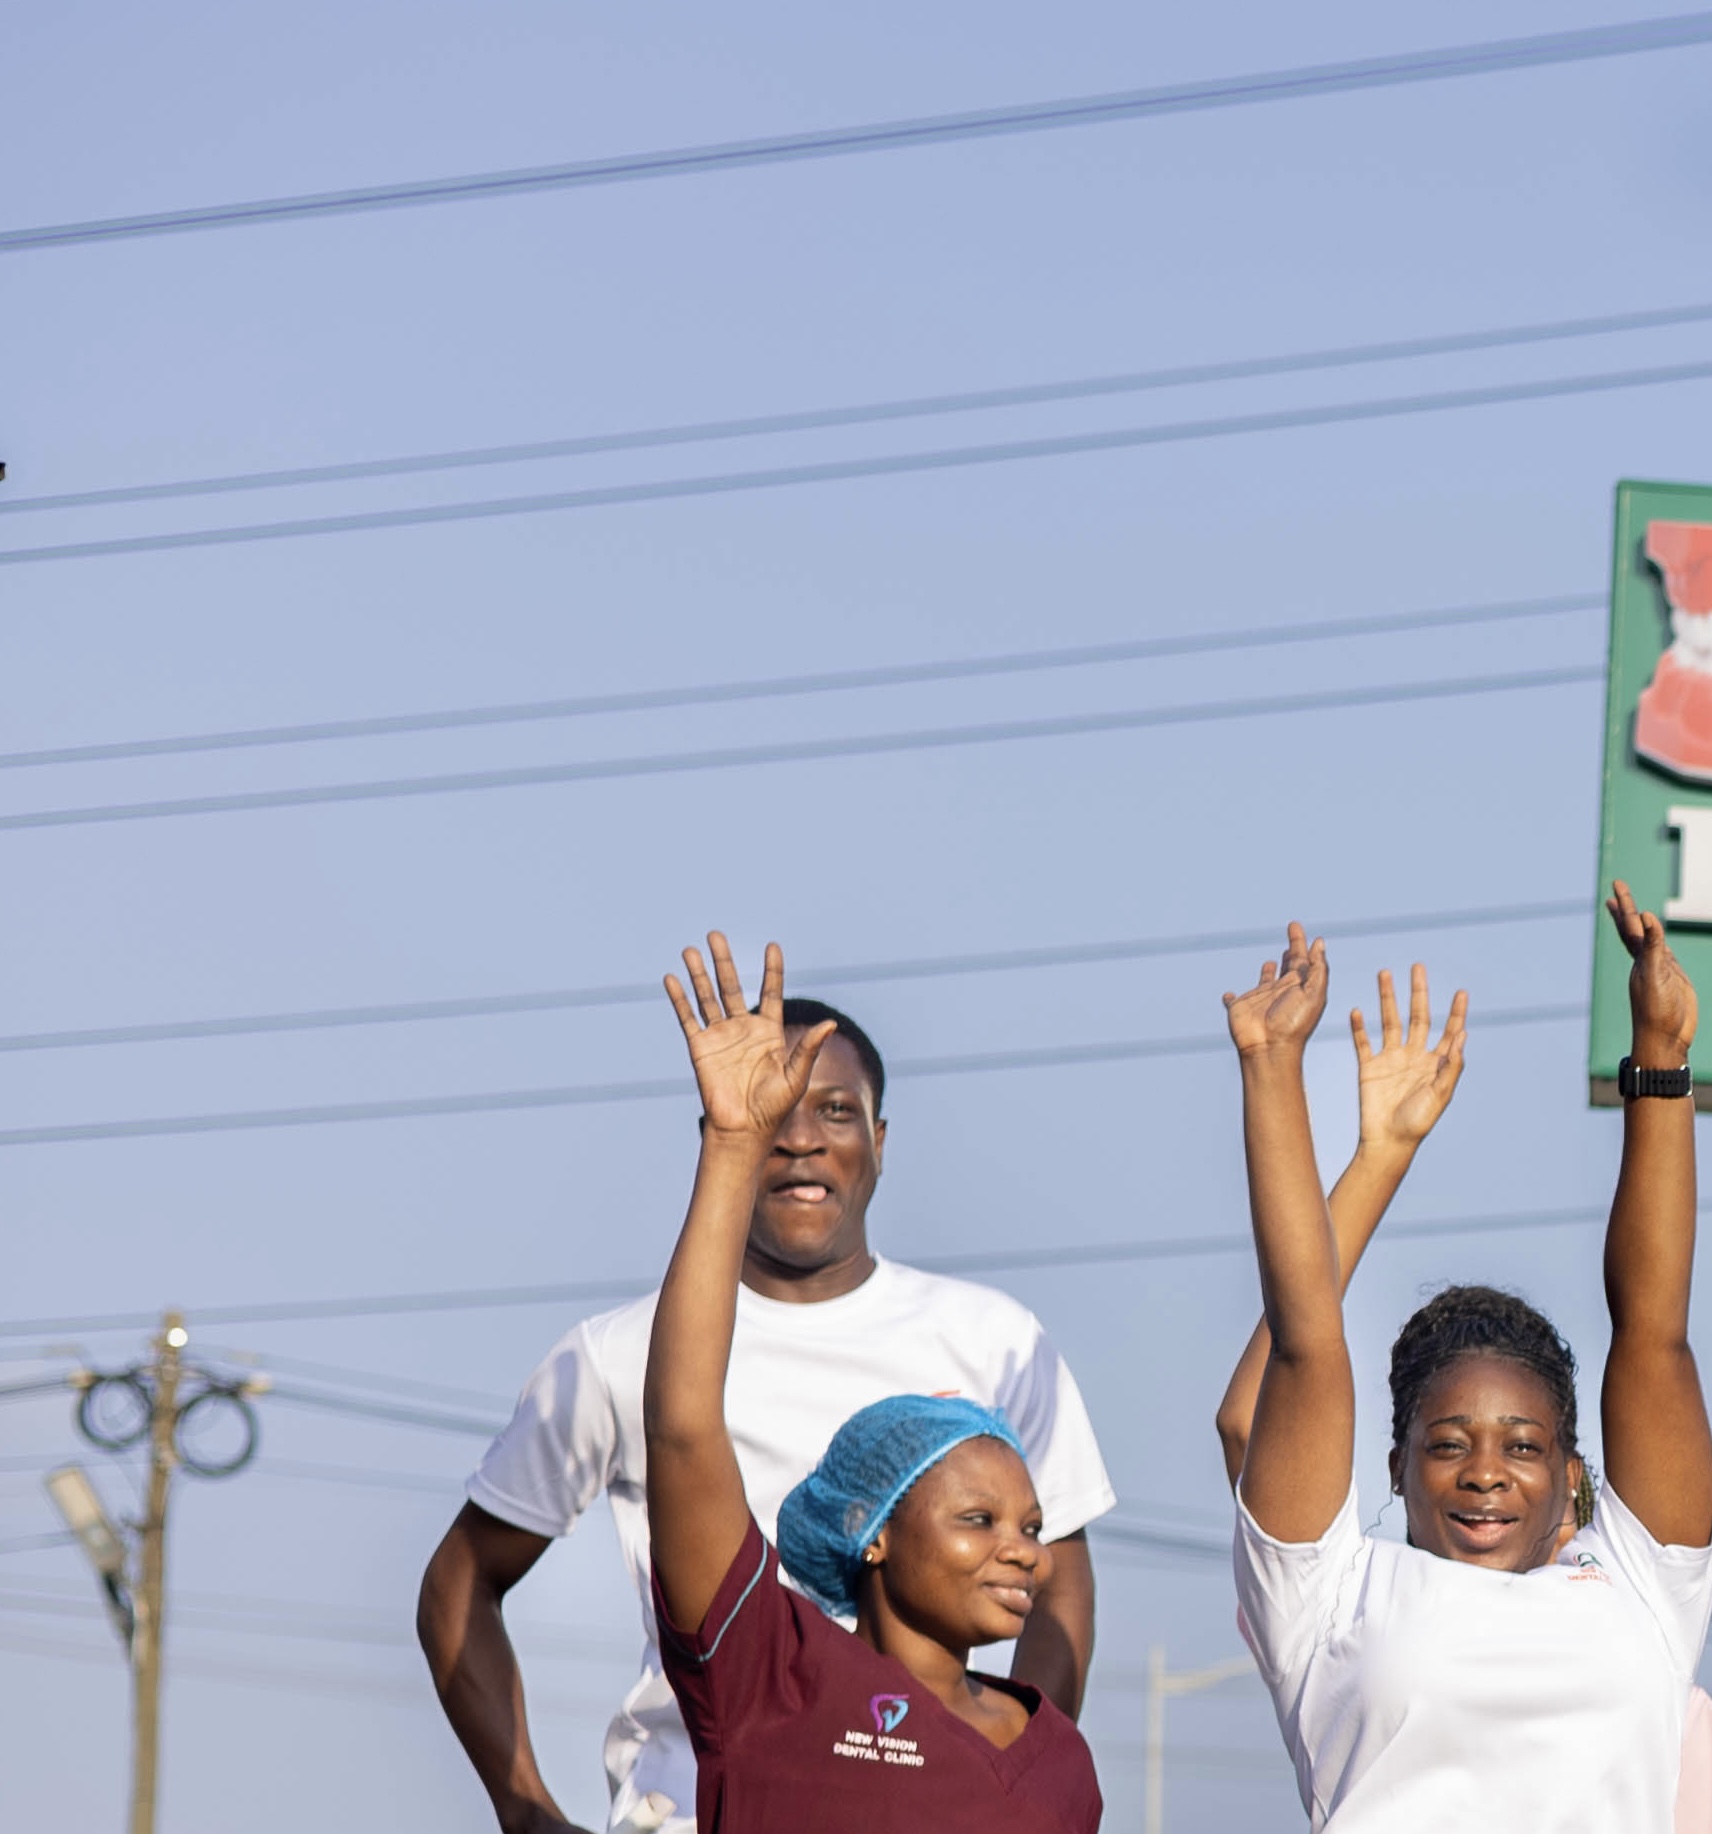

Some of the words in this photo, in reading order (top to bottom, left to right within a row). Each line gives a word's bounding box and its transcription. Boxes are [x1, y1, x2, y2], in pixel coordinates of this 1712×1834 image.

[845, 1730, 873, 1746] NEW
[877, 1736, 918, 1752] VISION
[833, 1742, 880, 1761] DENTAL
[884, 1751, 925, 1767] CLINIC
